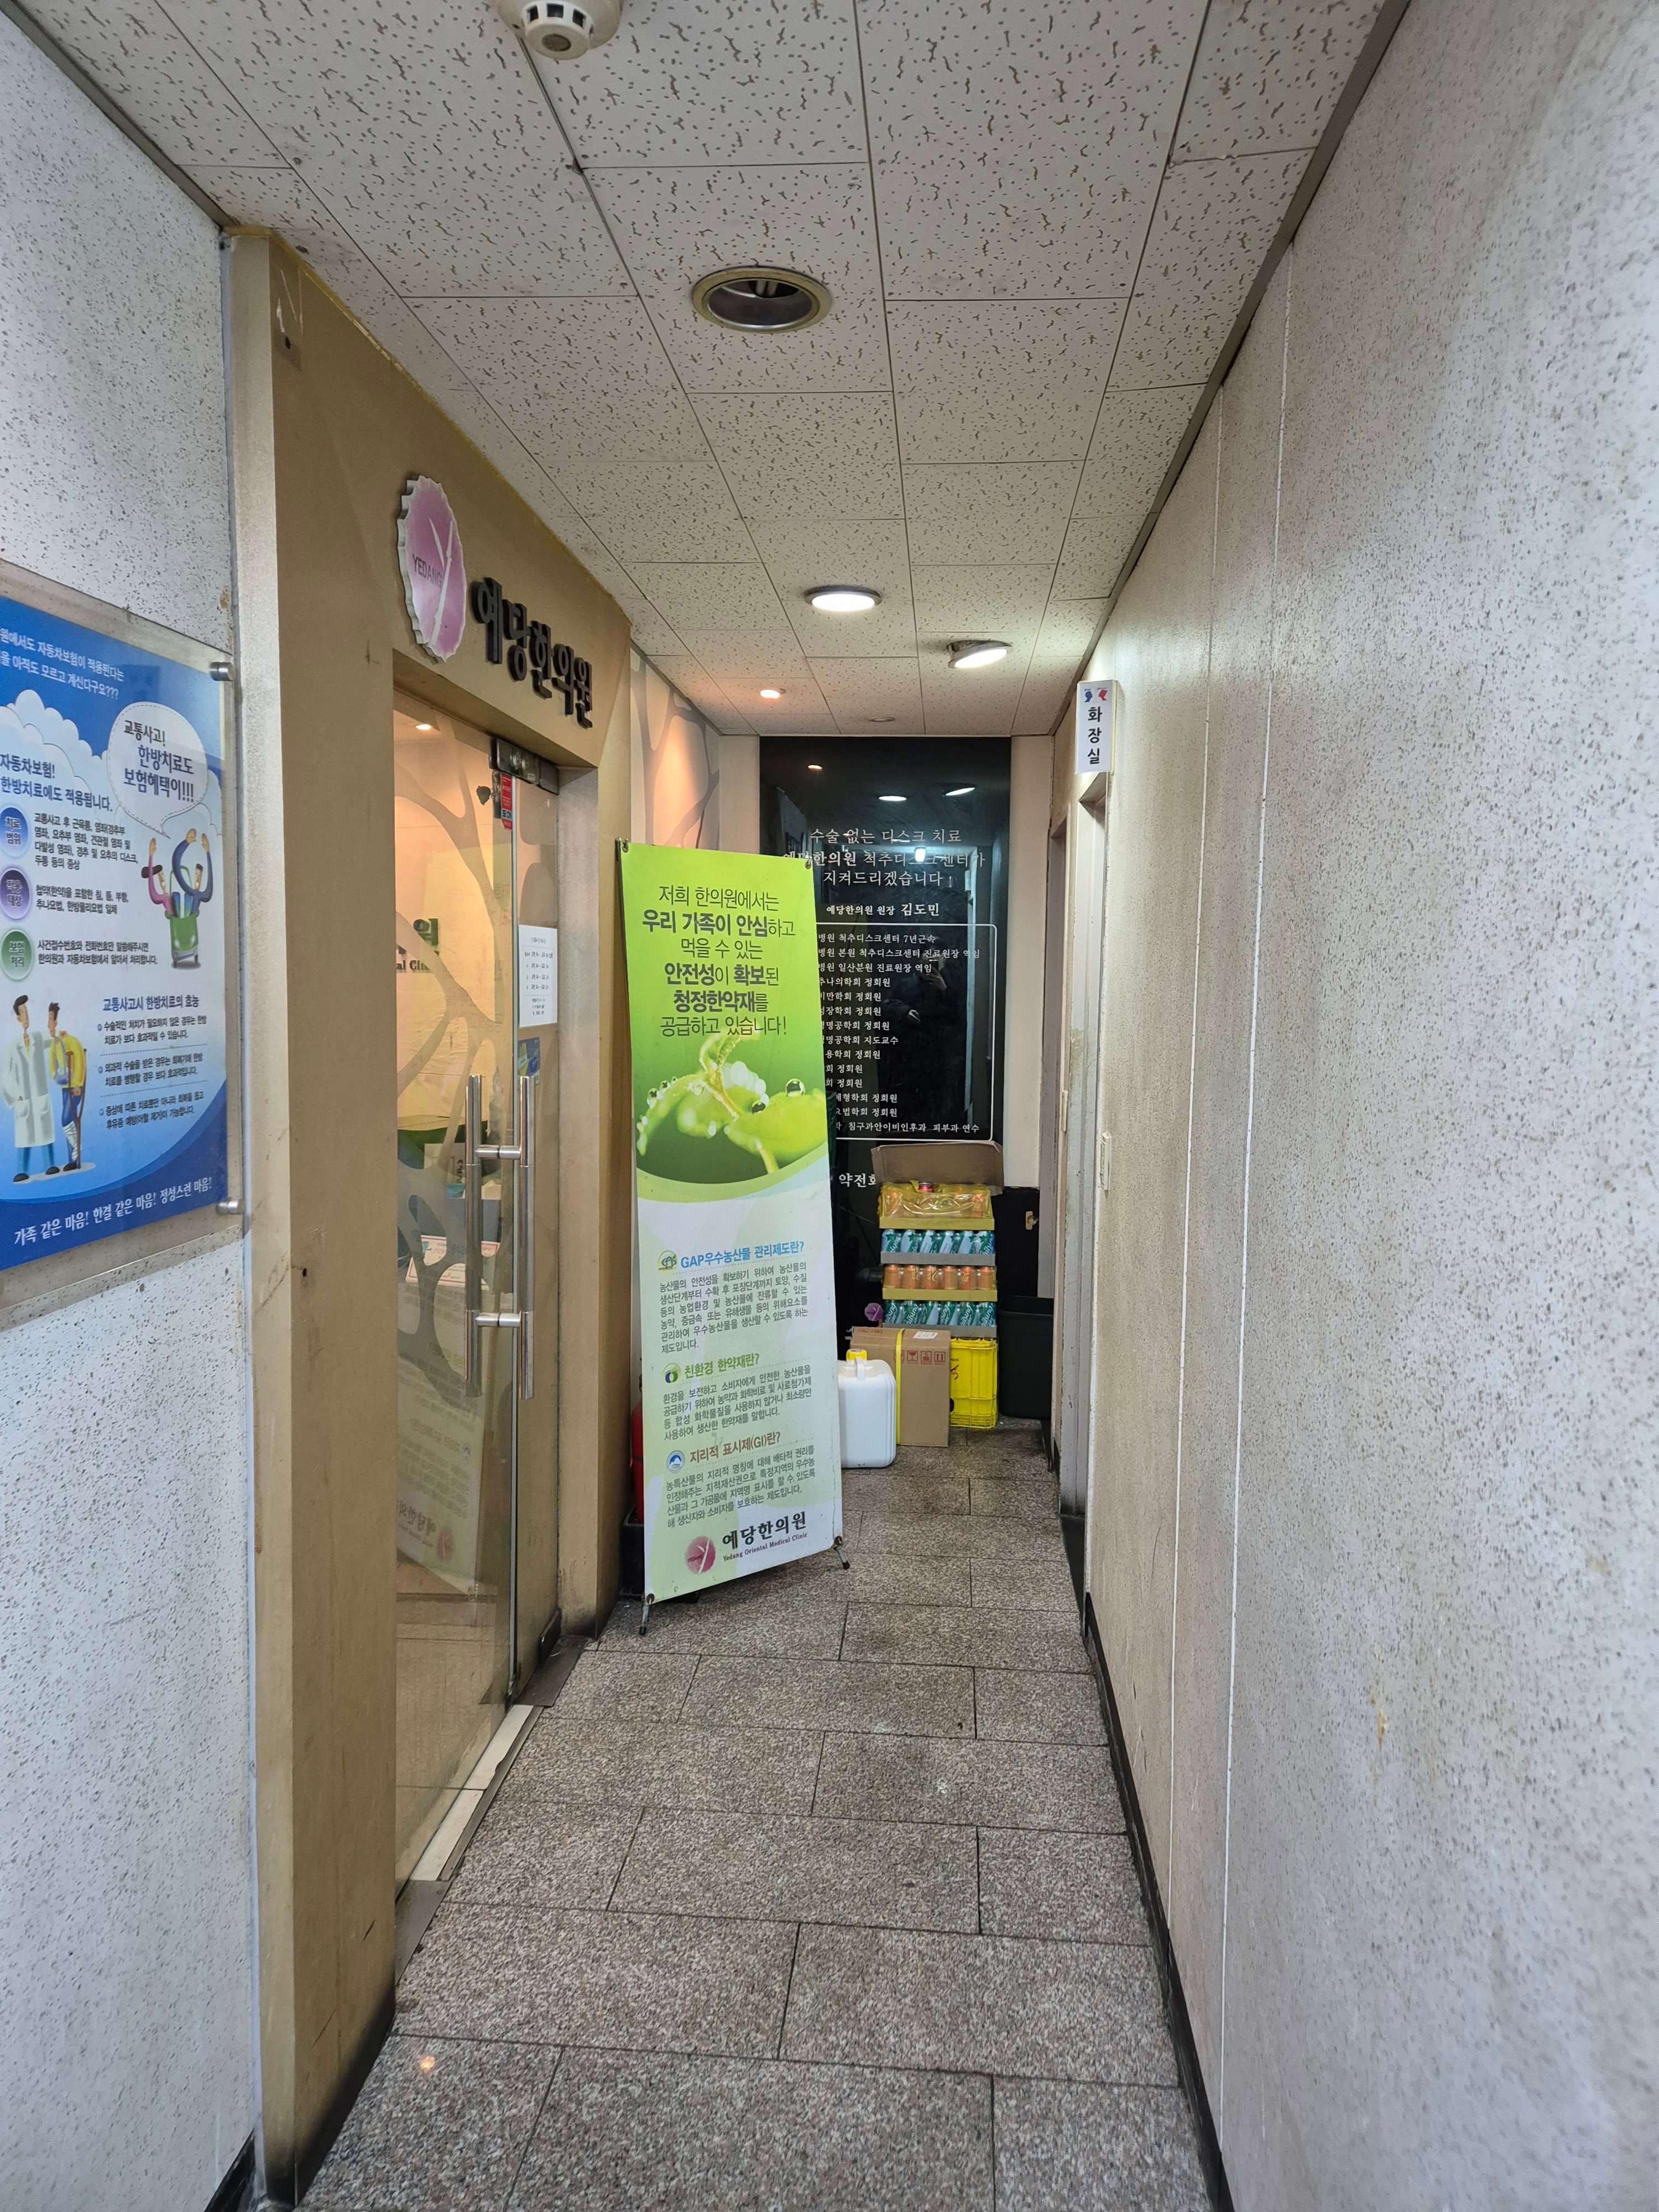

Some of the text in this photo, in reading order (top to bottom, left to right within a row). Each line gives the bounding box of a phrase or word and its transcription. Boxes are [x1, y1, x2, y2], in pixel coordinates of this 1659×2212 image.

[411, 554, 442, 586] YEDANG
[38, 641, 85, 669] 자동차보험이
[87, 658, 124, 682] 적용된다는
[471, 577, 592, 729] 예당한의원
[12, 656, 40, 674] 아직도
[41, 665, 66, 683] 모르고
[68, 674, 119, 700] 계신다구요???
[124, 720, 165, 747] 교통사고!
[1087, 706, 1103, 764] 화장실
[0, 754, 55, 779] 자동차보험!
[138, 745, 194, 774] 한방치료도
[1, 776, 113, 811] 한방치료에도 적용됩니다.
[124, 768, 194, 802] 보험혜택이!!!
[34, 813, 61, 825] 교통사고
[810, 828, 962, 844] 수술 없는 디스크 치료
[659, 885, 779, 911] 저희 한의원에서는
[827, 902, 940, 916] 예당한의원 원장 김도민
[642, 909, 796, 937] 우리 가족이 안심하고
[681, 938, 763, 959] 먹을 수 있는
[838, 933, 936, 943] 척추디스크센터 7년근속
[838, 948, 959, 958] 본원 척추디스크센터 진료원장
[664, 963, 779, 986] 안전성이 확보된
[838, 963, 932, 973] 일산분원 진료원장 역임
[864, 978, 890, 987] 정회원
[103, 995, 199, 1011] 교통사고시 한방치료의 효능
[674, 989, 769, 1013] 청정한약재를
[855, 992, 881, 1001] 정회원
[855, 1006, 881, 1016] 정회원
[660, 1016, 787, 1036] 공급하고 있습니다!
[864, 1021, 890, 1030] 정회원
[822, 1035, 899, 1045] 명공학회 지도교수
[855, 1050, 880, 1059] 정회원
[837, 1064, 863, 1073] 정회원
[837, 1079, 863, 1088] 정회원
[872, 1093, 898, 1103] 정회원
[872, 1108, 898, 1118] 정회원
[848, 1122, 927, 1132] 침구과안이비인후과
[933, 1123, 958, 1133] 피부과
[963, 1124, 980, 1133] 연수
[14, 1177, 212, 1246] 가족 같은 마음! 한결 같은 마음! 정성스런 마음!
[681, 1241, 805, 1269] GAP우수농산물 관리제도란?
[659, 1261, 806, 1293] 농산물의 안전성을 확보하기 위하여 농산물의
[722, 1284, 729, 1295] 후
[775, 1276, 790, 1286] 토양,
[793, 1273, 806, 1283] 수질
[660, 1285, 807, 1317] 등의 농업환경 및 농산물에 수 있는
[660, 1318, 677, 1330] 농약,
[681, 1313, 702, 1326] 중금속
[707, 1311, 721, 1321] 또는
[756, 1302, 769, 1313] 등의
[773, 1296, 807, 1310] 위해요소를
[661, 1307, 808, 1342] 관리하여 우수농산물을 생산할 수 있도록 하는
[662, 1338, 698, 1353] 제도입니다.
[685, 1353, 759, 1379] 친환경 한약재란?
[663, 1364, 811, 1404] 환경을 보전하고 소비자에게 안전한 농산물을
[664, 1376, 811, 1417] 공급하기 위하여 농약과 화학비료 및 사료첨가제
[664, 1418, 671, 1430] 등
[676, 1413, 690, 1426] 합성
[695, 1405, 731, 1421] 화학물질을
[735, 1398, 761, 1412] 사용하지
[664, 1406, 780, 1441] 사용하여 생산한 한약재를 말합니다.
[690, 1431, 780, 1463] 지리적 표시제(GI)란?
[666, 1472, 703, 1491] 농특산물의
[708, 1466, 729, 1479] 지리적
[758, 1455, 770, 1466] 대해
[774, 1451, 792, 1463] 배타적
[667, 1458, 815, 1504] 인정해주는 지적재산권으로 특정지역의 우수농
[667, 1501, 688, 1516] 산물과
[691, 1500, 698, 1509] 그
[796, 1468, 815, 1481] 있도록
[667, 1484, 802, 1527] 해 생산자와 소비자를 보호하는 제도입니다.
[722, 1511, 806, 1550] 예당한의원
[723, 1532, 808, 1562] Yedang Oriental Medical Clinic
